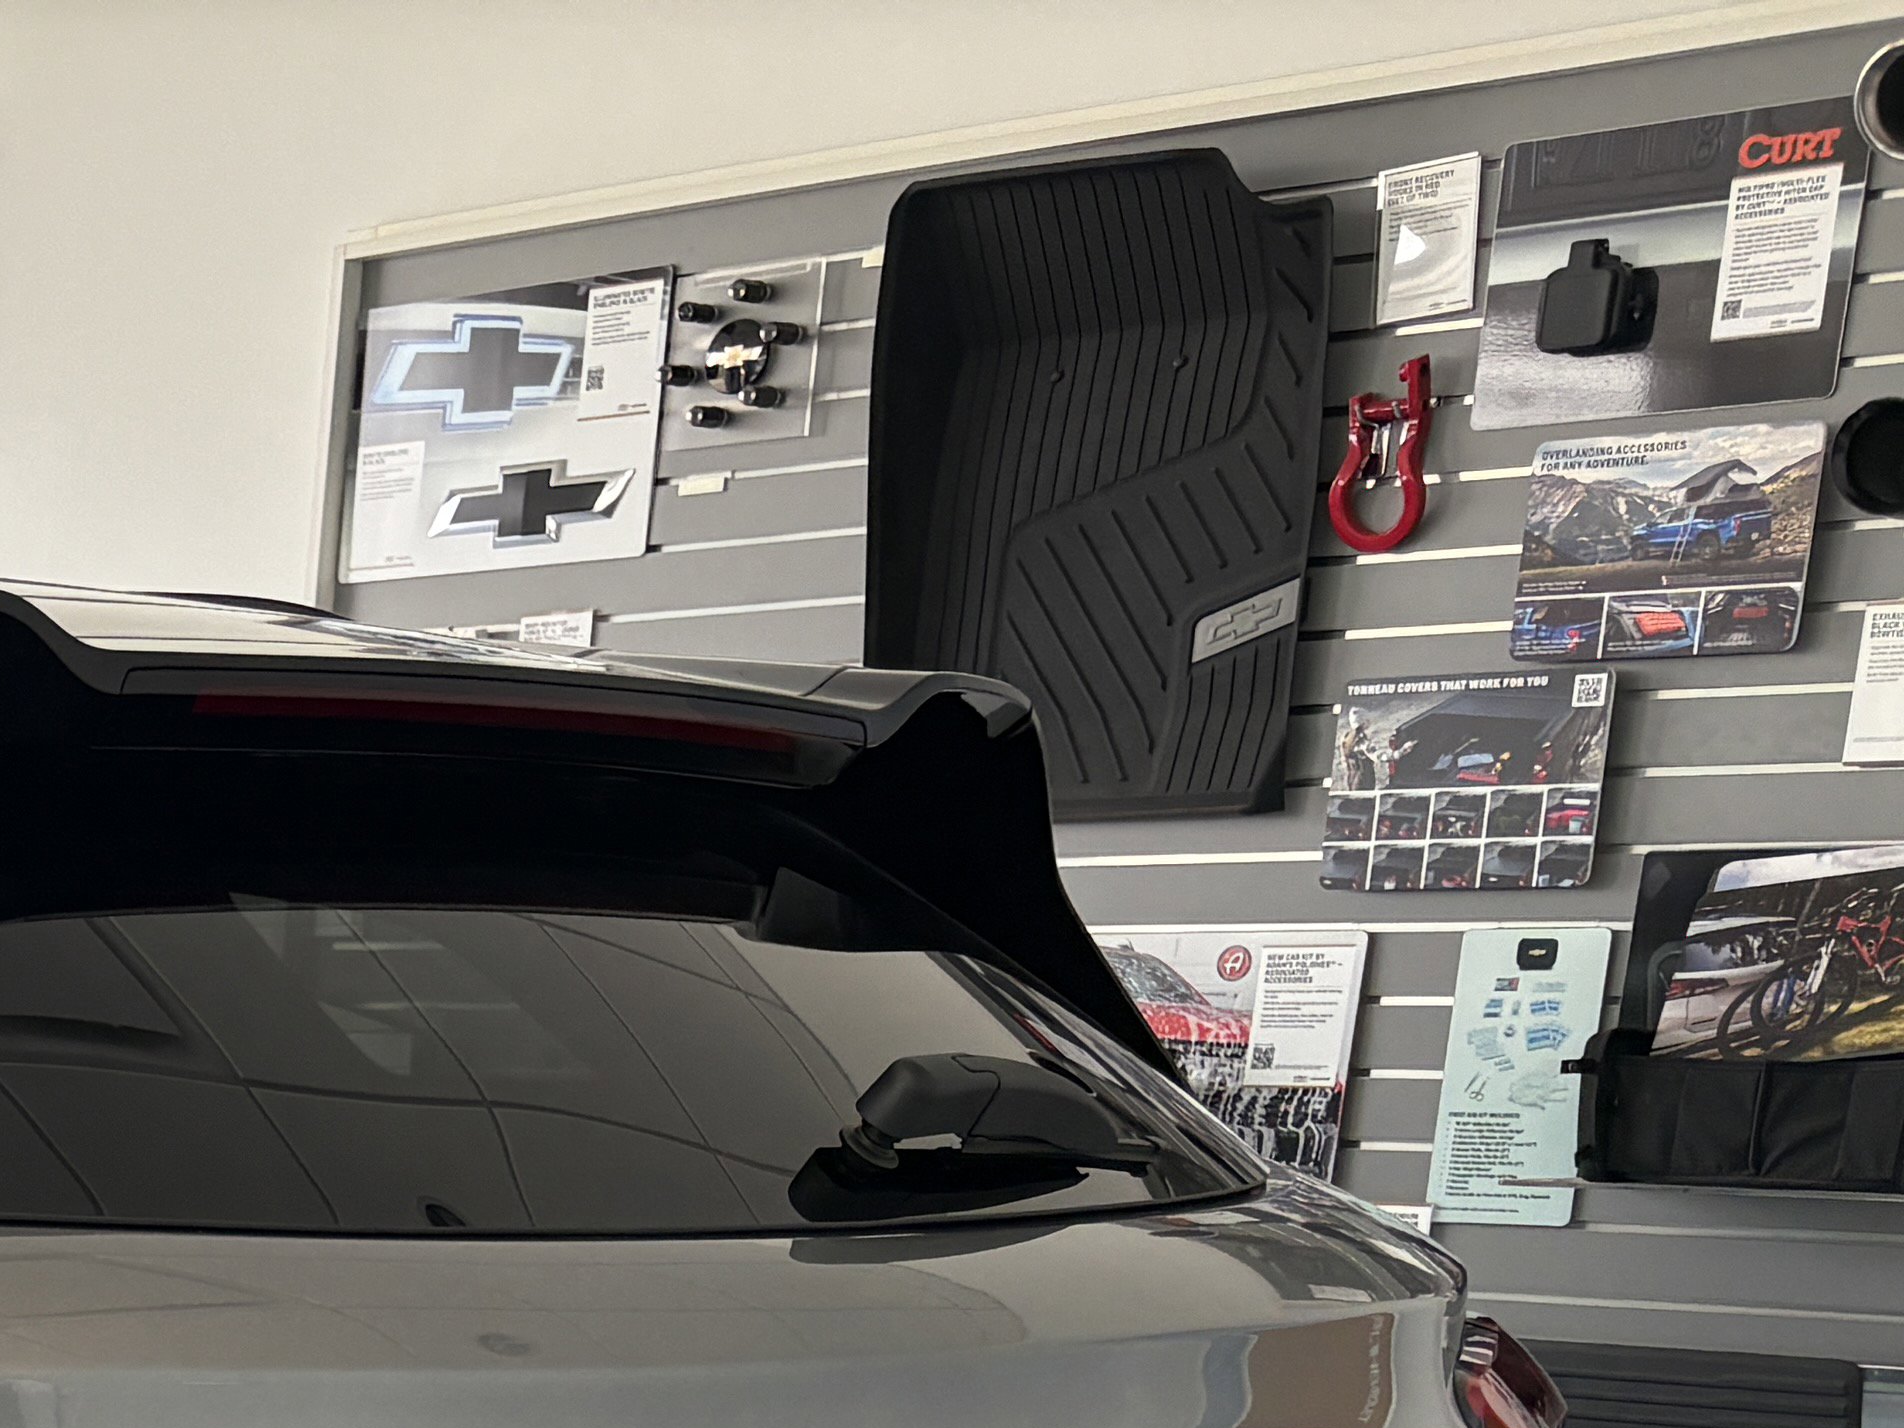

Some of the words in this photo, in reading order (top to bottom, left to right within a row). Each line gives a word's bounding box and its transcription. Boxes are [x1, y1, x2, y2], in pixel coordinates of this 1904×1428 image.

[1738, 127, 1842, 169] CURT
[1542, 445, 1613, 461] OVERLANDING
[1615, 440, 1688, 455] ACCESSORIES
[1540, 462, 1560, 472] FOR
[1562, 460, 1584, 471] ANY
[1347, 683, 1395, 696] TONNEAU
[1397, 682, 1439, 694] COVERS
[1440, 679, 1467, 691] THAT
[1468, 678, 1501, 690] WORK
[1502, 677, 1525, 688] FOR
[1526, 675, 1549, 687] YOU
